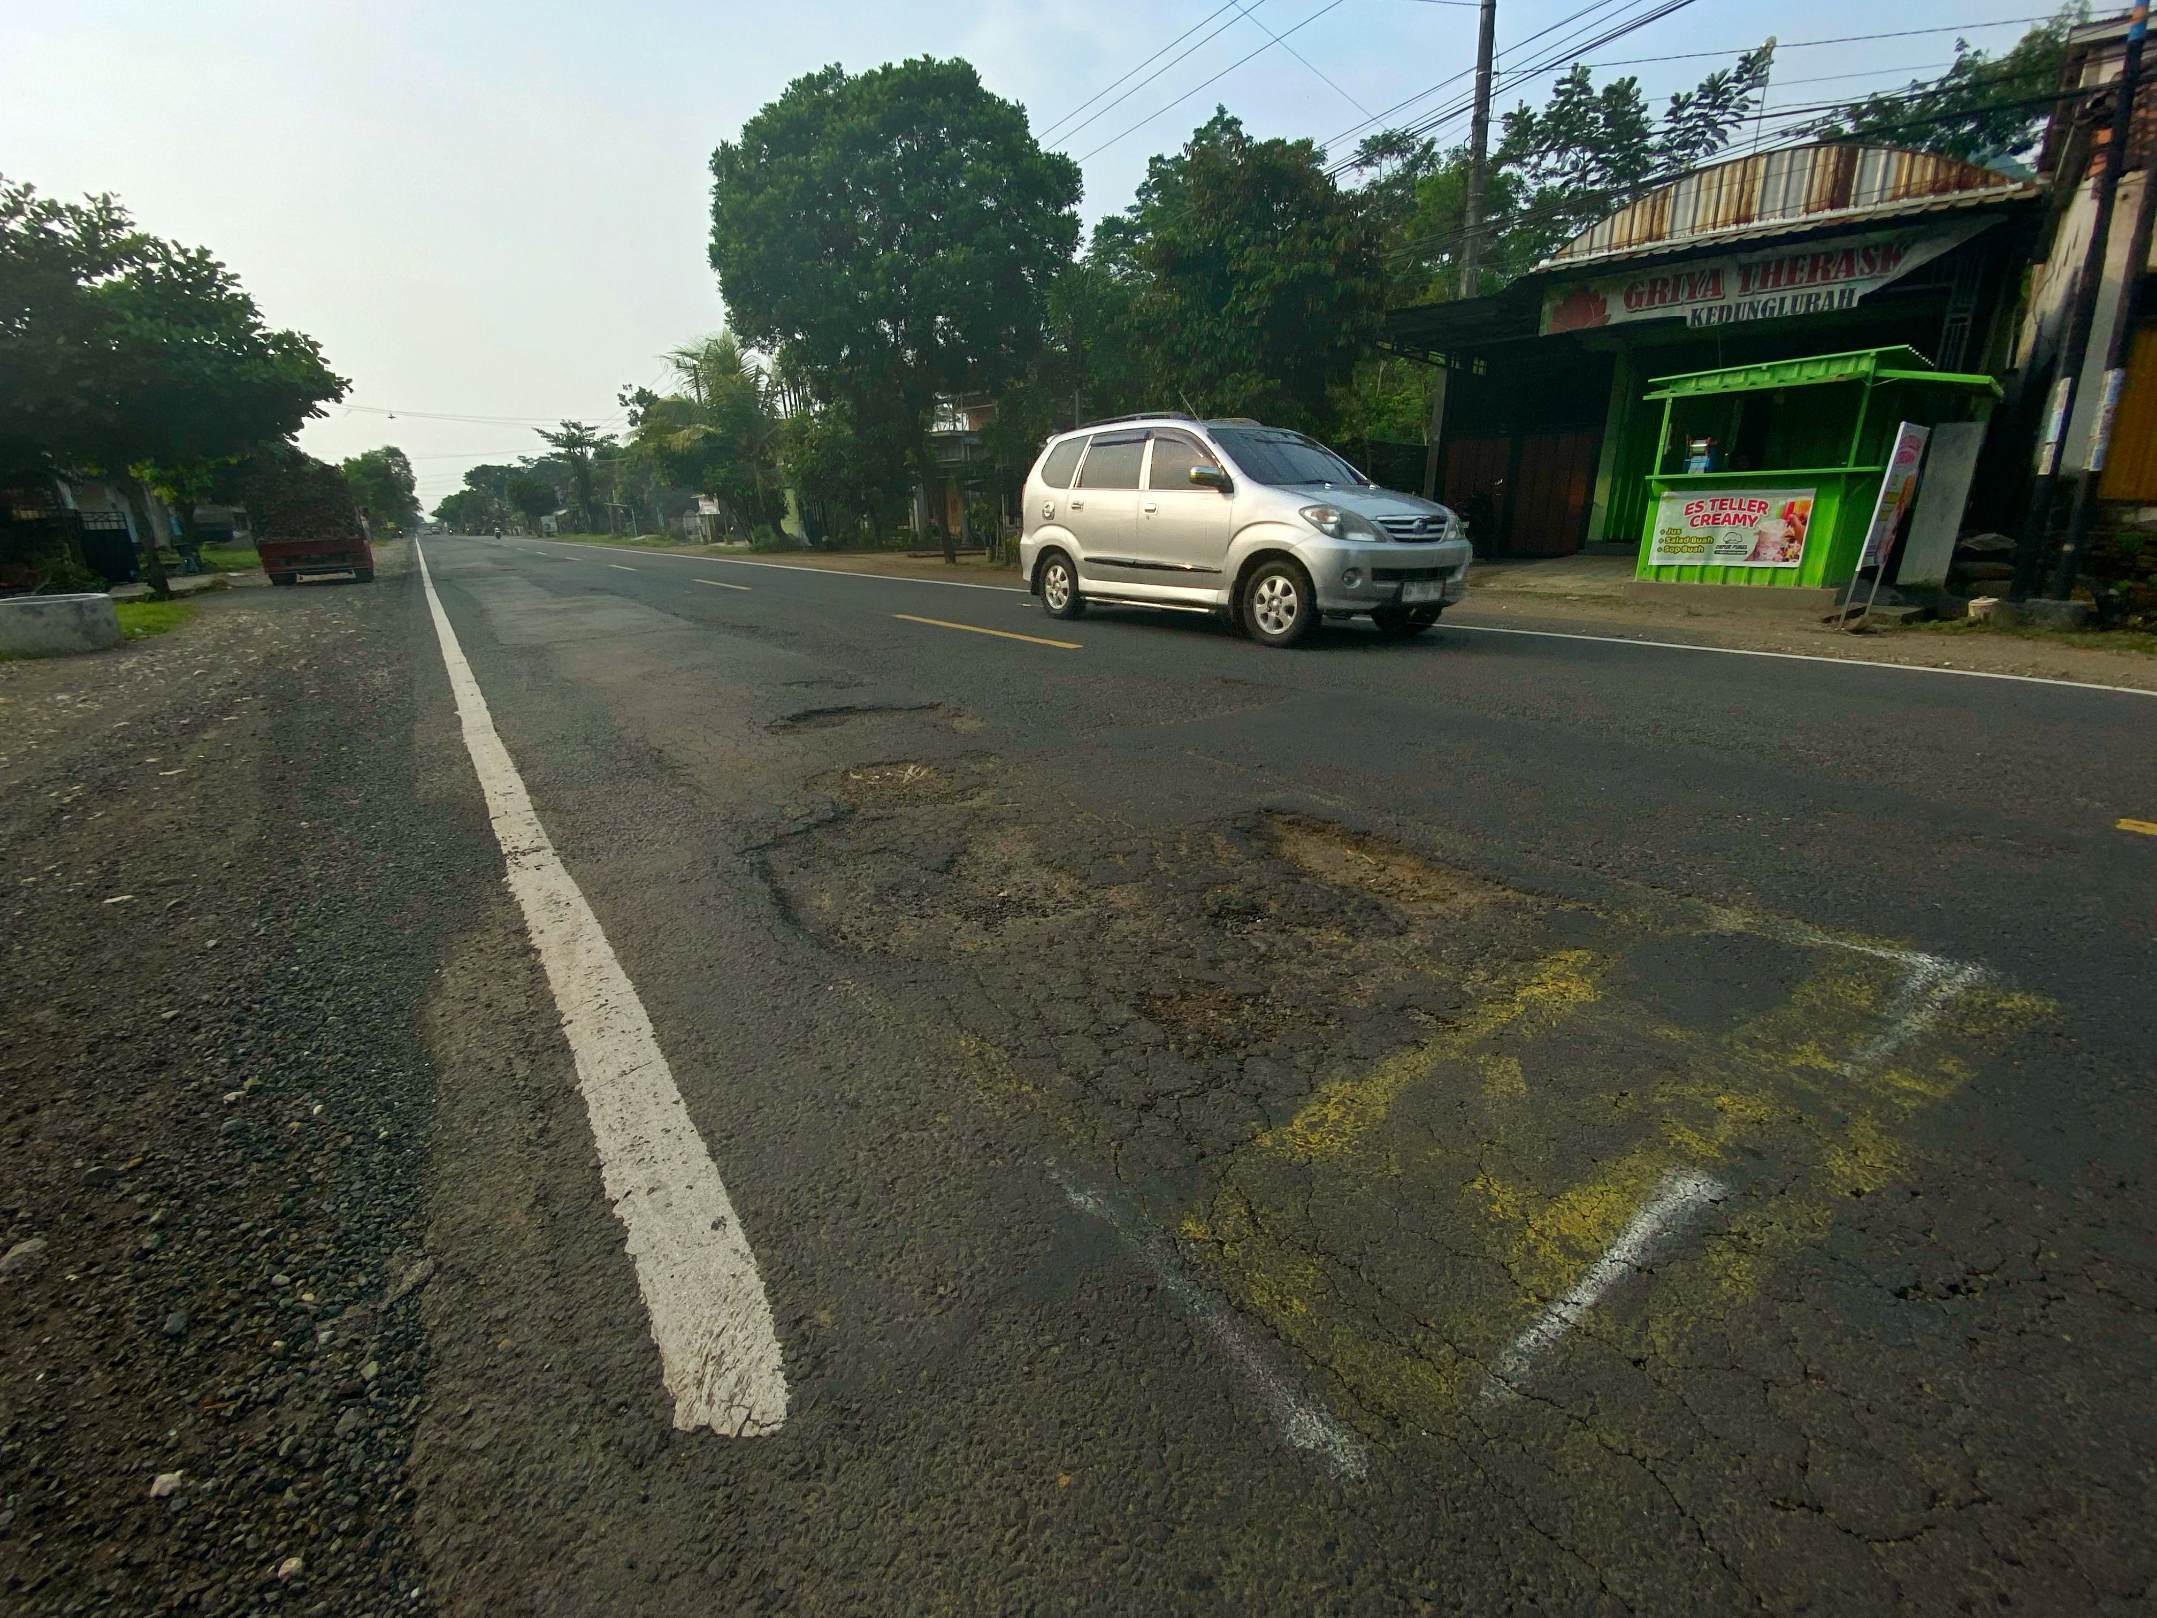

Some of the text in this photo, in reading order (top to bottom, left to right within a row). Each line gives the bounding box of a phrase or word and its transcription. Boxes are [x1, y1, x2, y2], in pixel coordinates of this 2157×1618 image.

[1624, 268, 1725, 311] GRIYA
[1689, 287, 1857, 328] KEDUNGLURAH
[1684, 498, 1769, 516] ES TELLER
[1690, 513, 1759, 528] CREAMY
